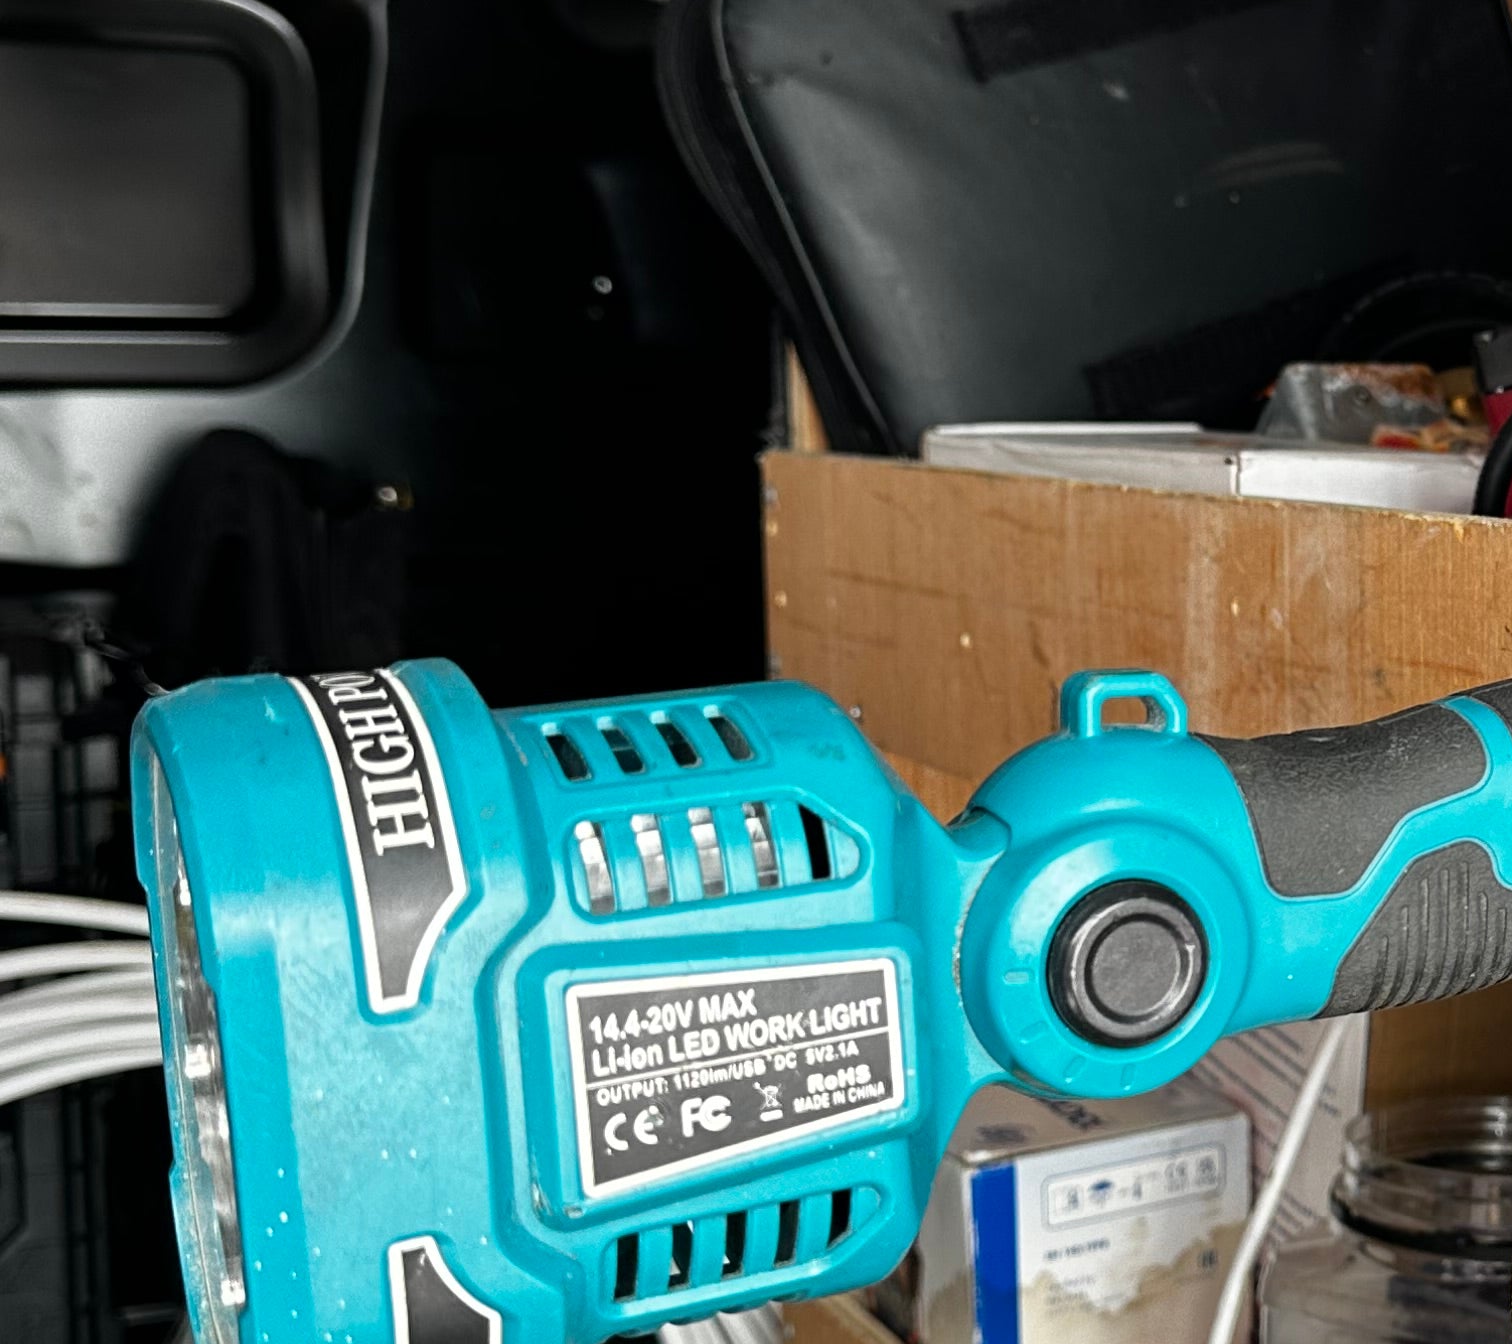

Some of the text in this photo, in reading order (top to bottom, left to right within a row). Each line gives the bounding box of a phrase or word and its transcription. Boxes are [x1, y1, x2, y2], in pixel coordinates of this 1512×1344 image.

[339, 704, 436, 857] HIGH
[589, 987, 758, 1045] 14.4-20V MAX
[667, 1027, 721, 1063] LED
[723, 1011, 806, 1052] WORK
[808, 996, 883, 1036] LIGHT
[596, 1076, 670, 1107] OUTPUT:
[792, 1081, 886, 1114] MADE IN CHINA
[806, 1063, 873, 1094] RoHS
[603, 1105, 661, 1152] CE
